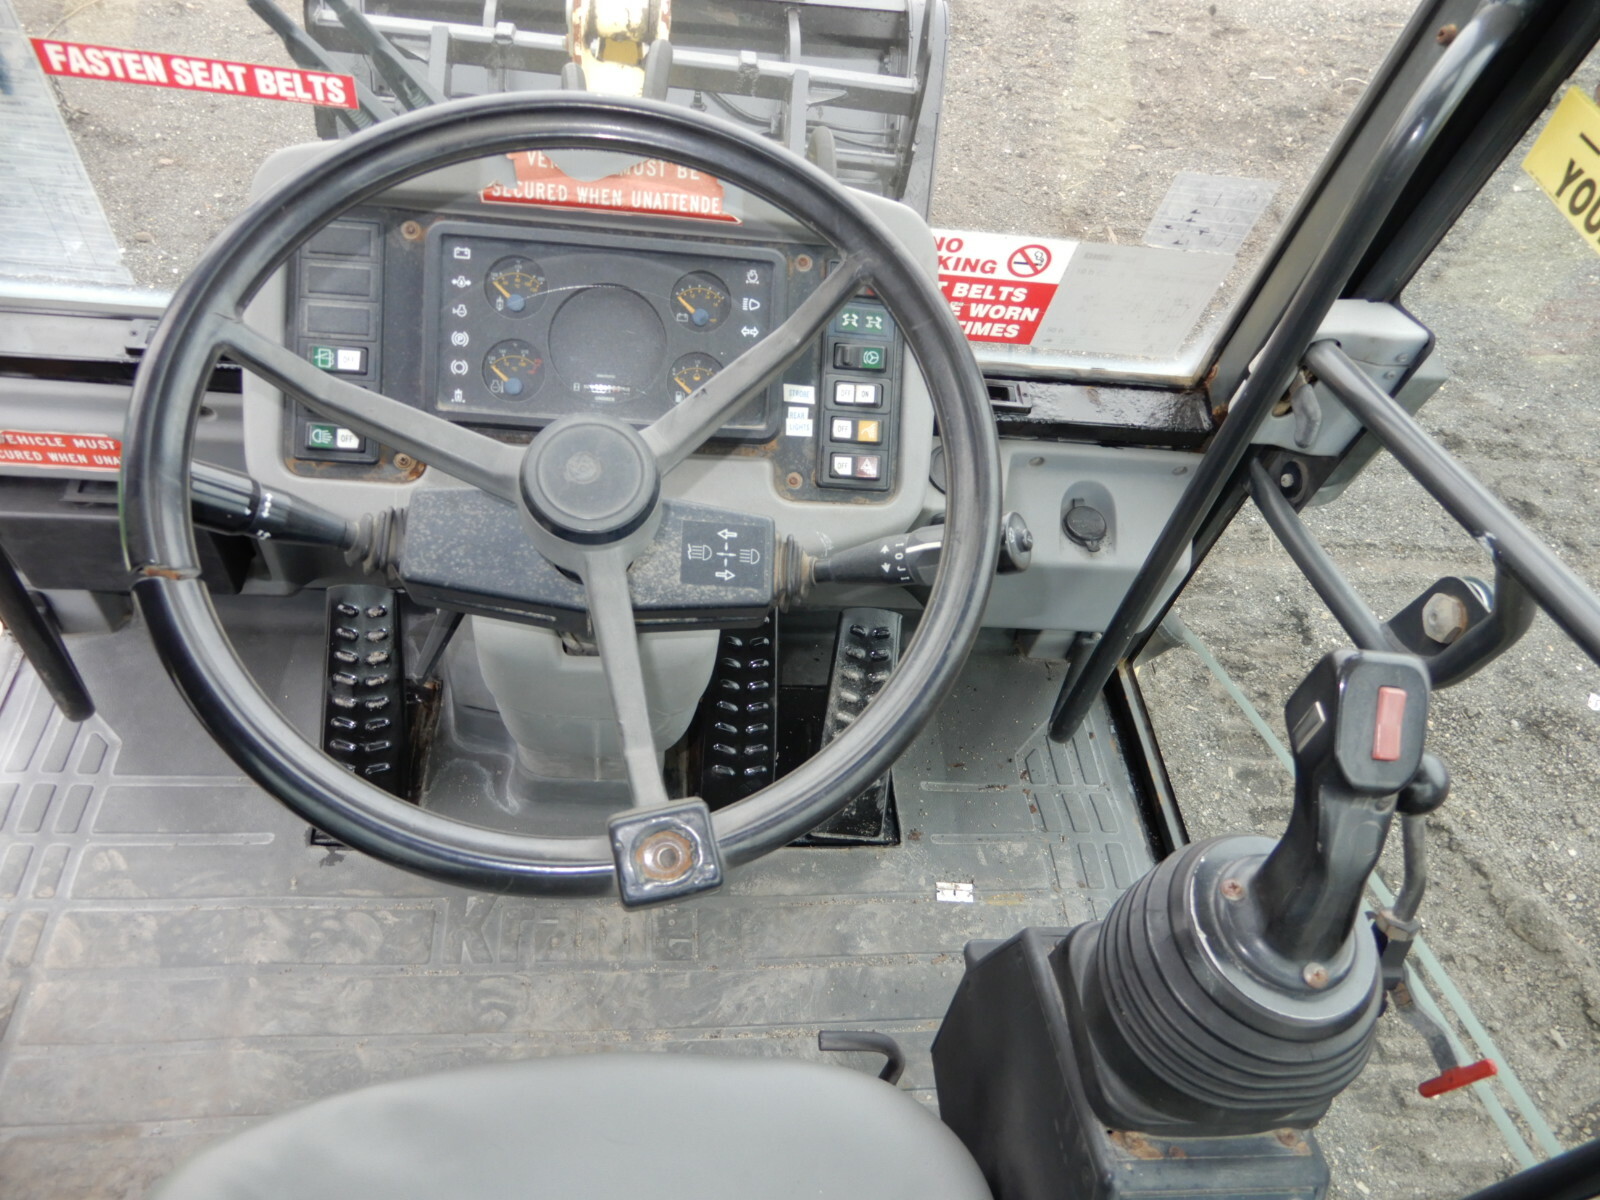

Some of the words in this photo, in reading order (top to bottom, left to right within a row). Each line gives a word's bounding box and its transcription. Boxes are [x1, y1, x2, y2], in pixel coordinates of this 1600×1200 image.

[43, 42, 169, 83] FASTEN
[171, 57, 247, 92] SEAT
[254, 67, 347, 103] BELTS
[577, 185, 622, 206] WHEN
[951, 282, 1028, 303] BELTS
[969, 302, 1040, 322] WORN
[790, 411, 805, 419] REAR
[789, 423, 810, 431] LIGHTS
[837, 425, 848, 433] OFF
[72, 438, 116, 450] MUST
[340, 434, 353, 442] OFF
[46, 451, 88, 464] WHEN
[837, 462, 848, 470] OFF
